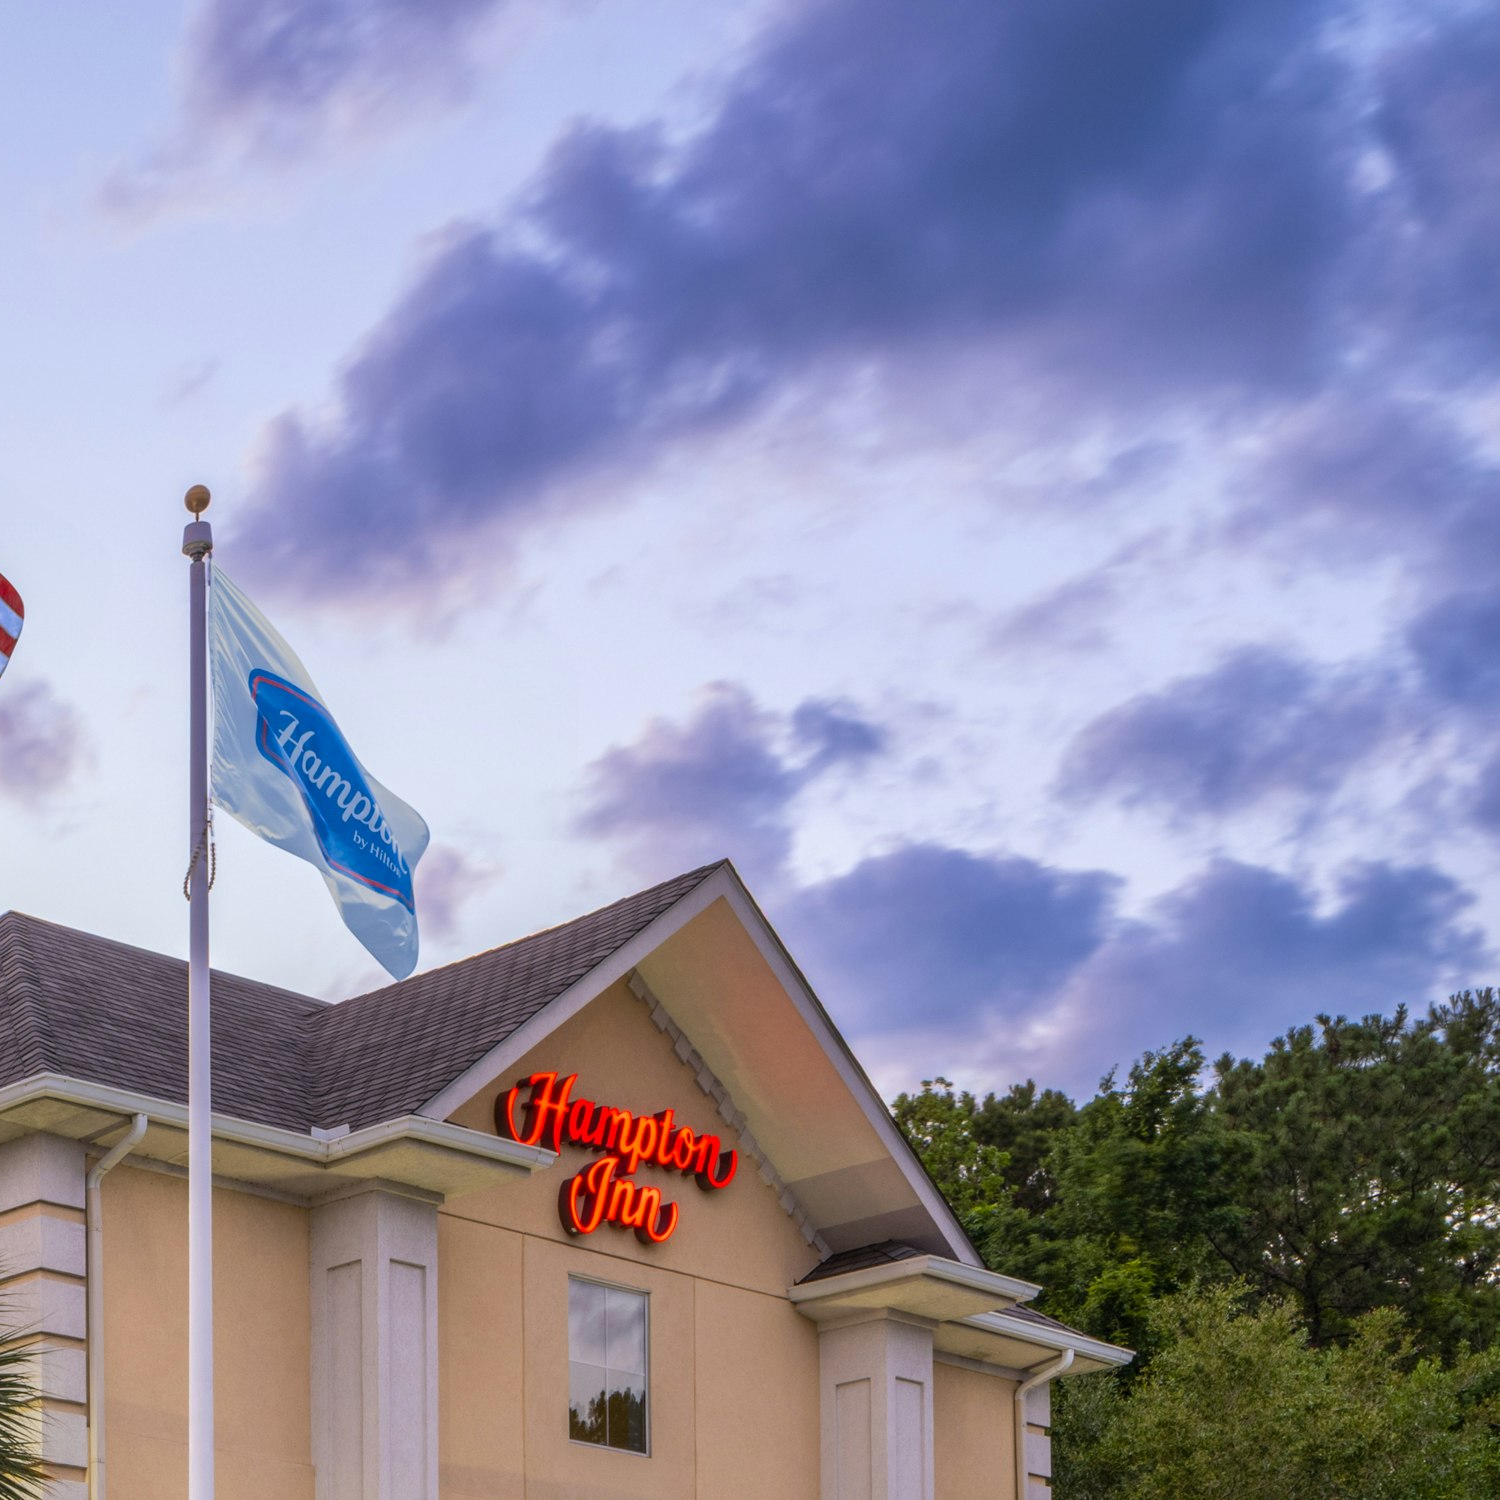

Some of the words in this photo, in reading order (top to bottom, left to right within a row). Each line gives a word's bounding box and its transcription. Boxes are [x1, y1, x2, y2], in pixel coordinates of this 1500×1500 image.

[278, 710, 408, 875] Hampton
[353, 829, 369, 850] by
[370, 842, 402, 879] Hilton
[504, 1071, 738, 1189] Hampton
[567, 1156, 679, 1243] Inn
